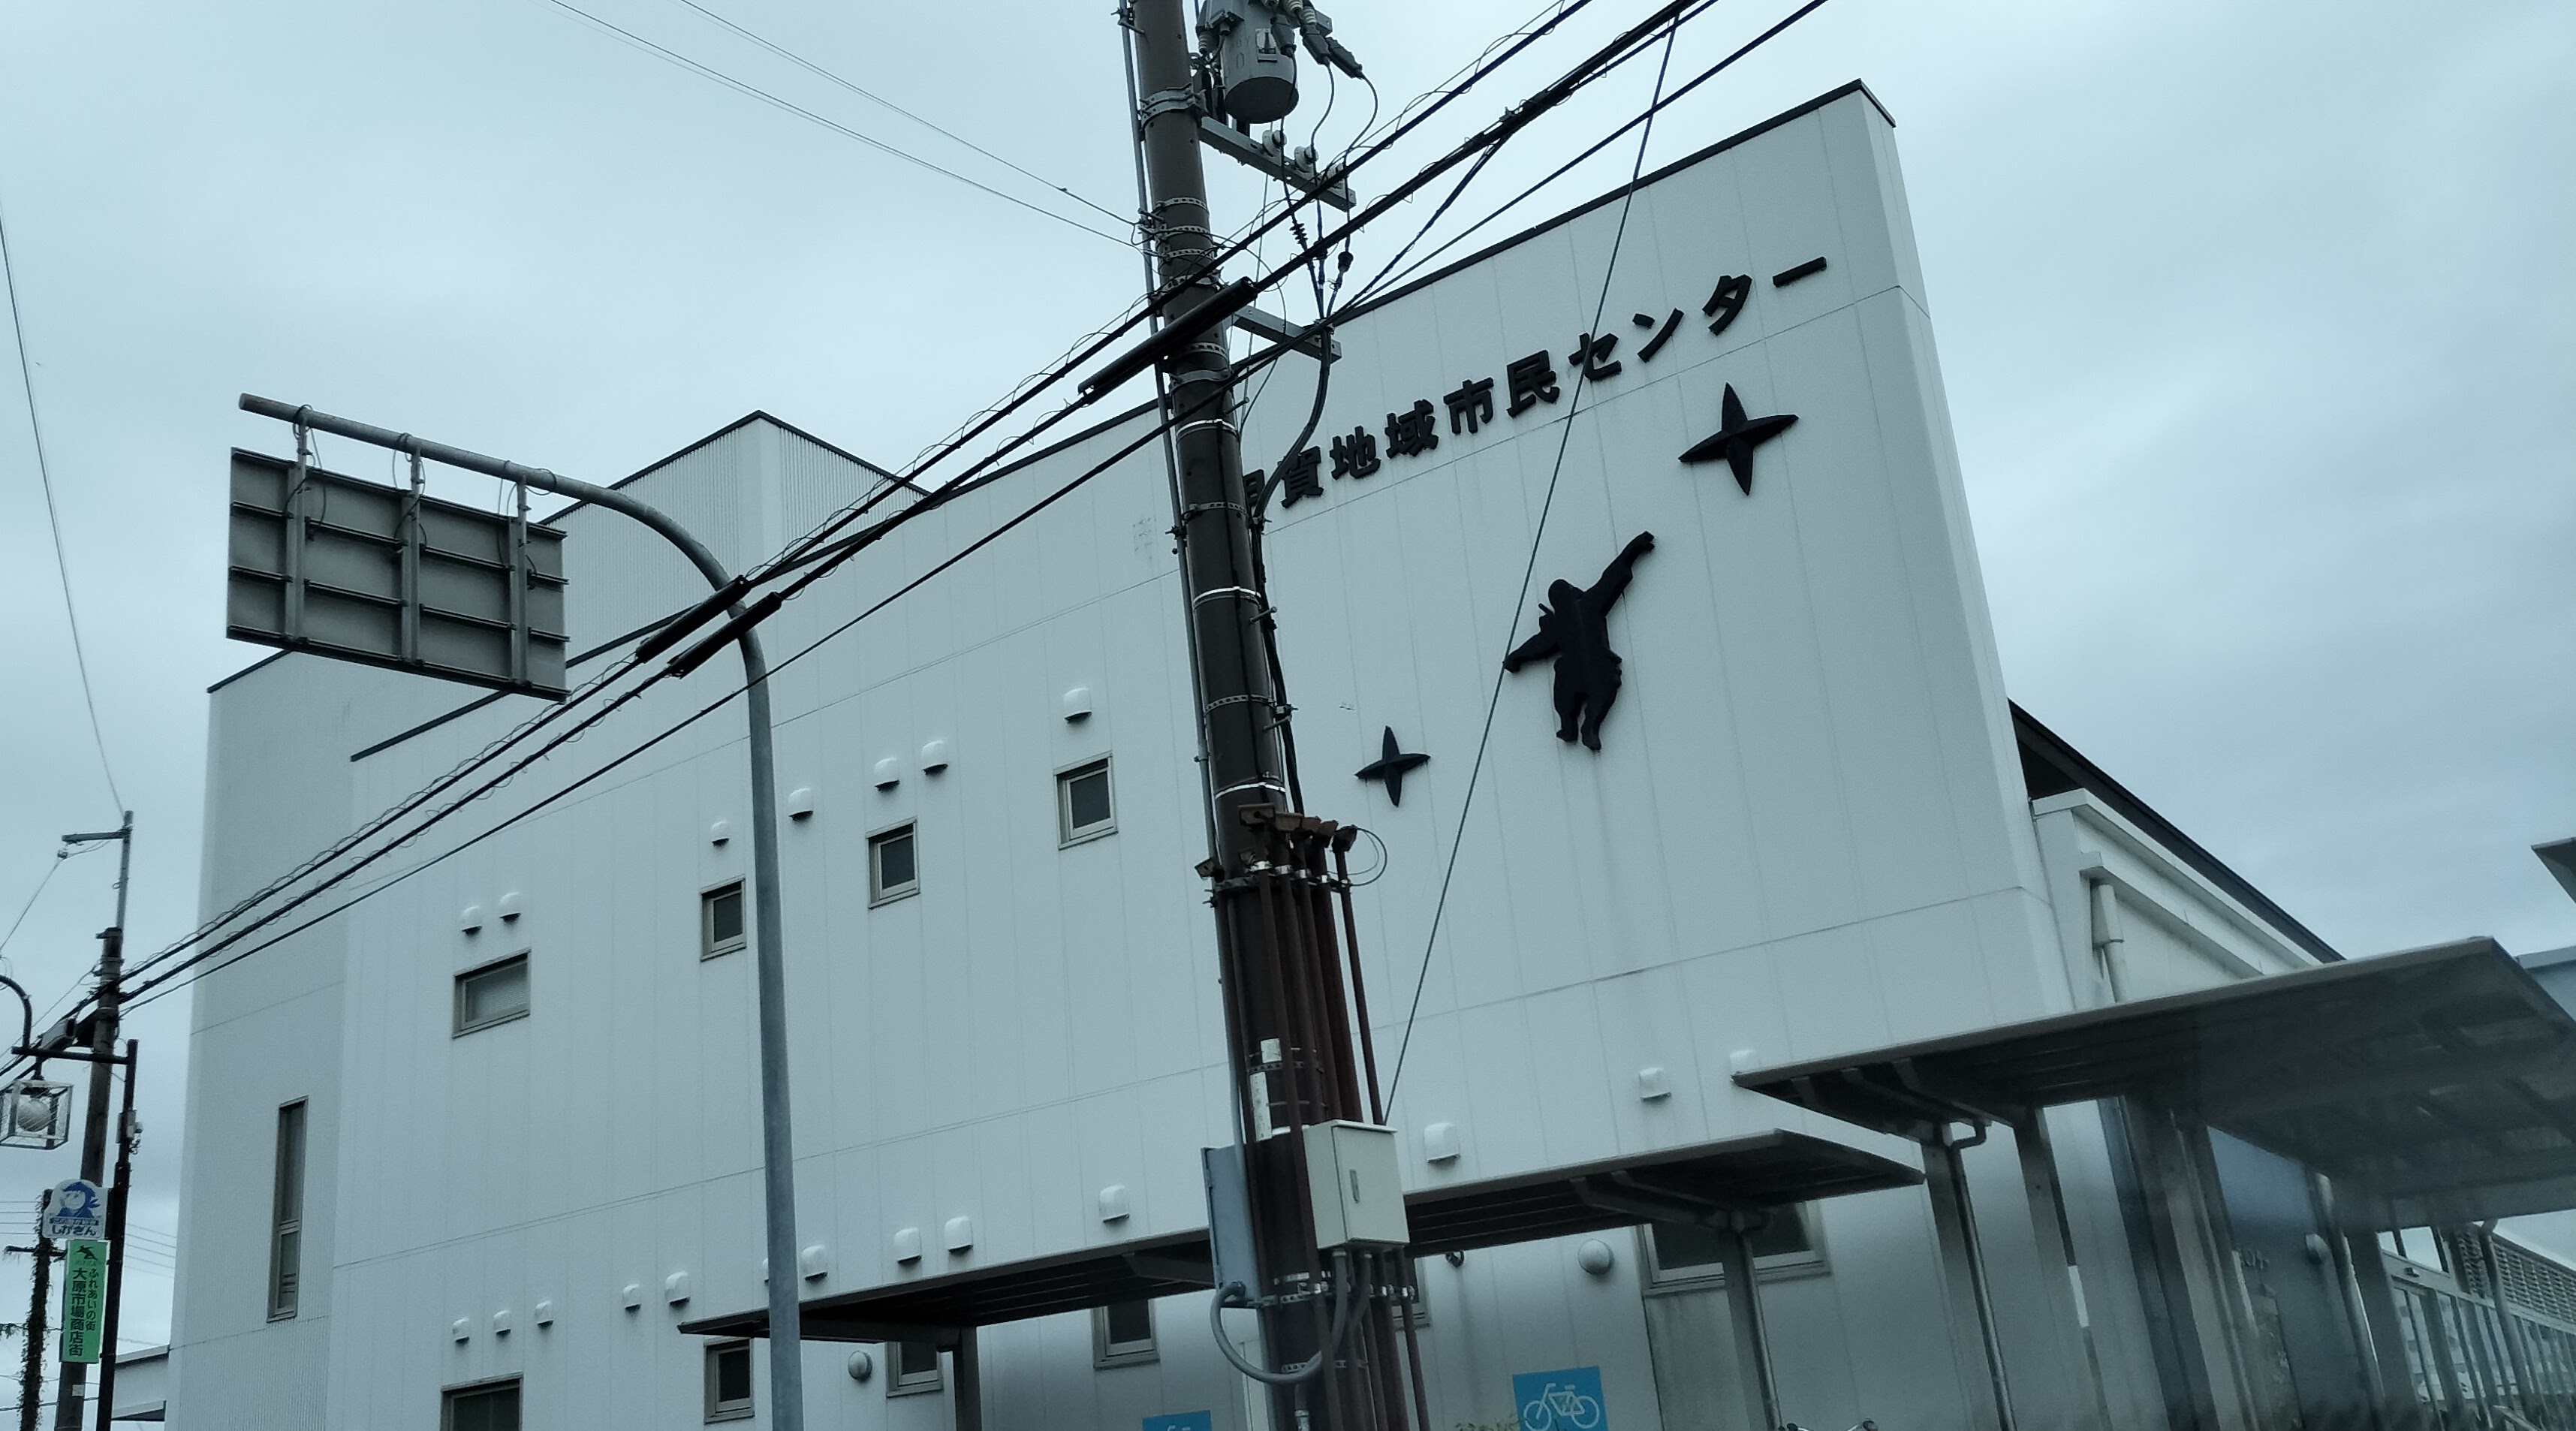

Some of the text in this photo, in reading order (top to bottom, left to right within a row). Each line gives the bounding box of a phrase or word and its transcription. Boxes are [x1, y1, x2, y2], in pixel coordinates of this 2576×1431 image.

[52, 1224, 97, 1237] しがぎん
[68, 1267, 88, 1357] 大原市場商店街
[85, 1267, 99, 1332] ふれあいの街
